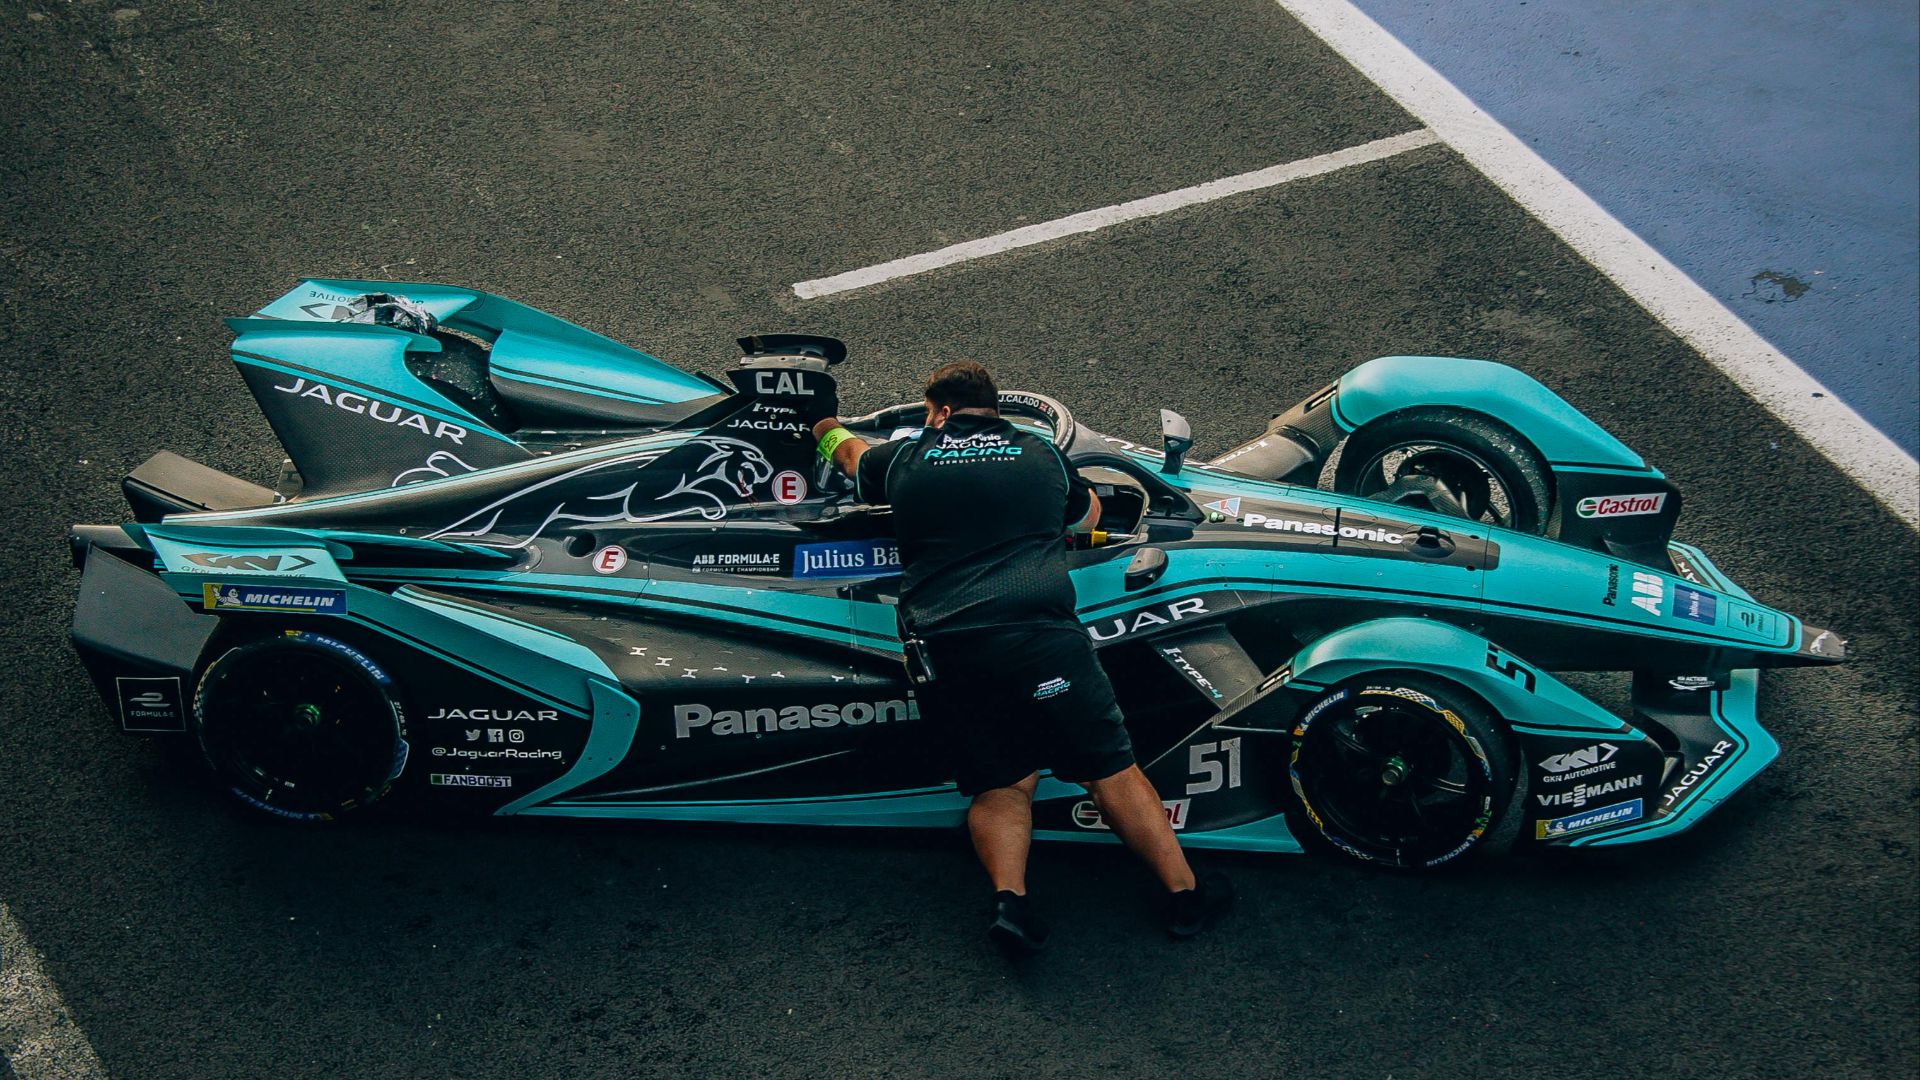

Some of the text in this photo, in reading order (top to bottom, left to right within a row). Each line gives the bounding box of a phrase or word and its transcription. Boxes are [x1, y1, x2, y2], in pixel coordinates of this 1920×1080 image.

[755, 371, 815, 395] CAL
[274, 378, 467, 445] JAGUAR
[998, 394, 1039, 407] J.CALADO
[924, 447, 1022, 459] RACING
[782, 477, 797, 499] E
[1597, 495, 1658, 515] Castrol
[1243, 513, 1403, 545] Panasonic
[600, 551, 619, 569] E
[693, 554, 715, 564] ABB
[802, 547, 901, 573] Julius Bä
[1602, 563, 1618, 606] Panasonic
[1631, 571, 1663, 616] ABB
[245, 593, 334, 607] MICHELIN
[1087, 597, 1209, 642] UAR
[428, 708, 558, 721] JAGUAR
[674, 690, 920, 738] Panasoni
[1304, 691, 1344, 722] MICHELIN
[432, 747, 562, 760] @JaguarRacing
[1186, 737, 1241, 795] 51
[1543, 761, 1617, 783] GKN AUTOMOTIVE
[1663, 740, 1732, 806] JAGUAR
[444, 775, 511, 787] FANBOOST
[1567, 806, 1634, 829] MICHELIN
